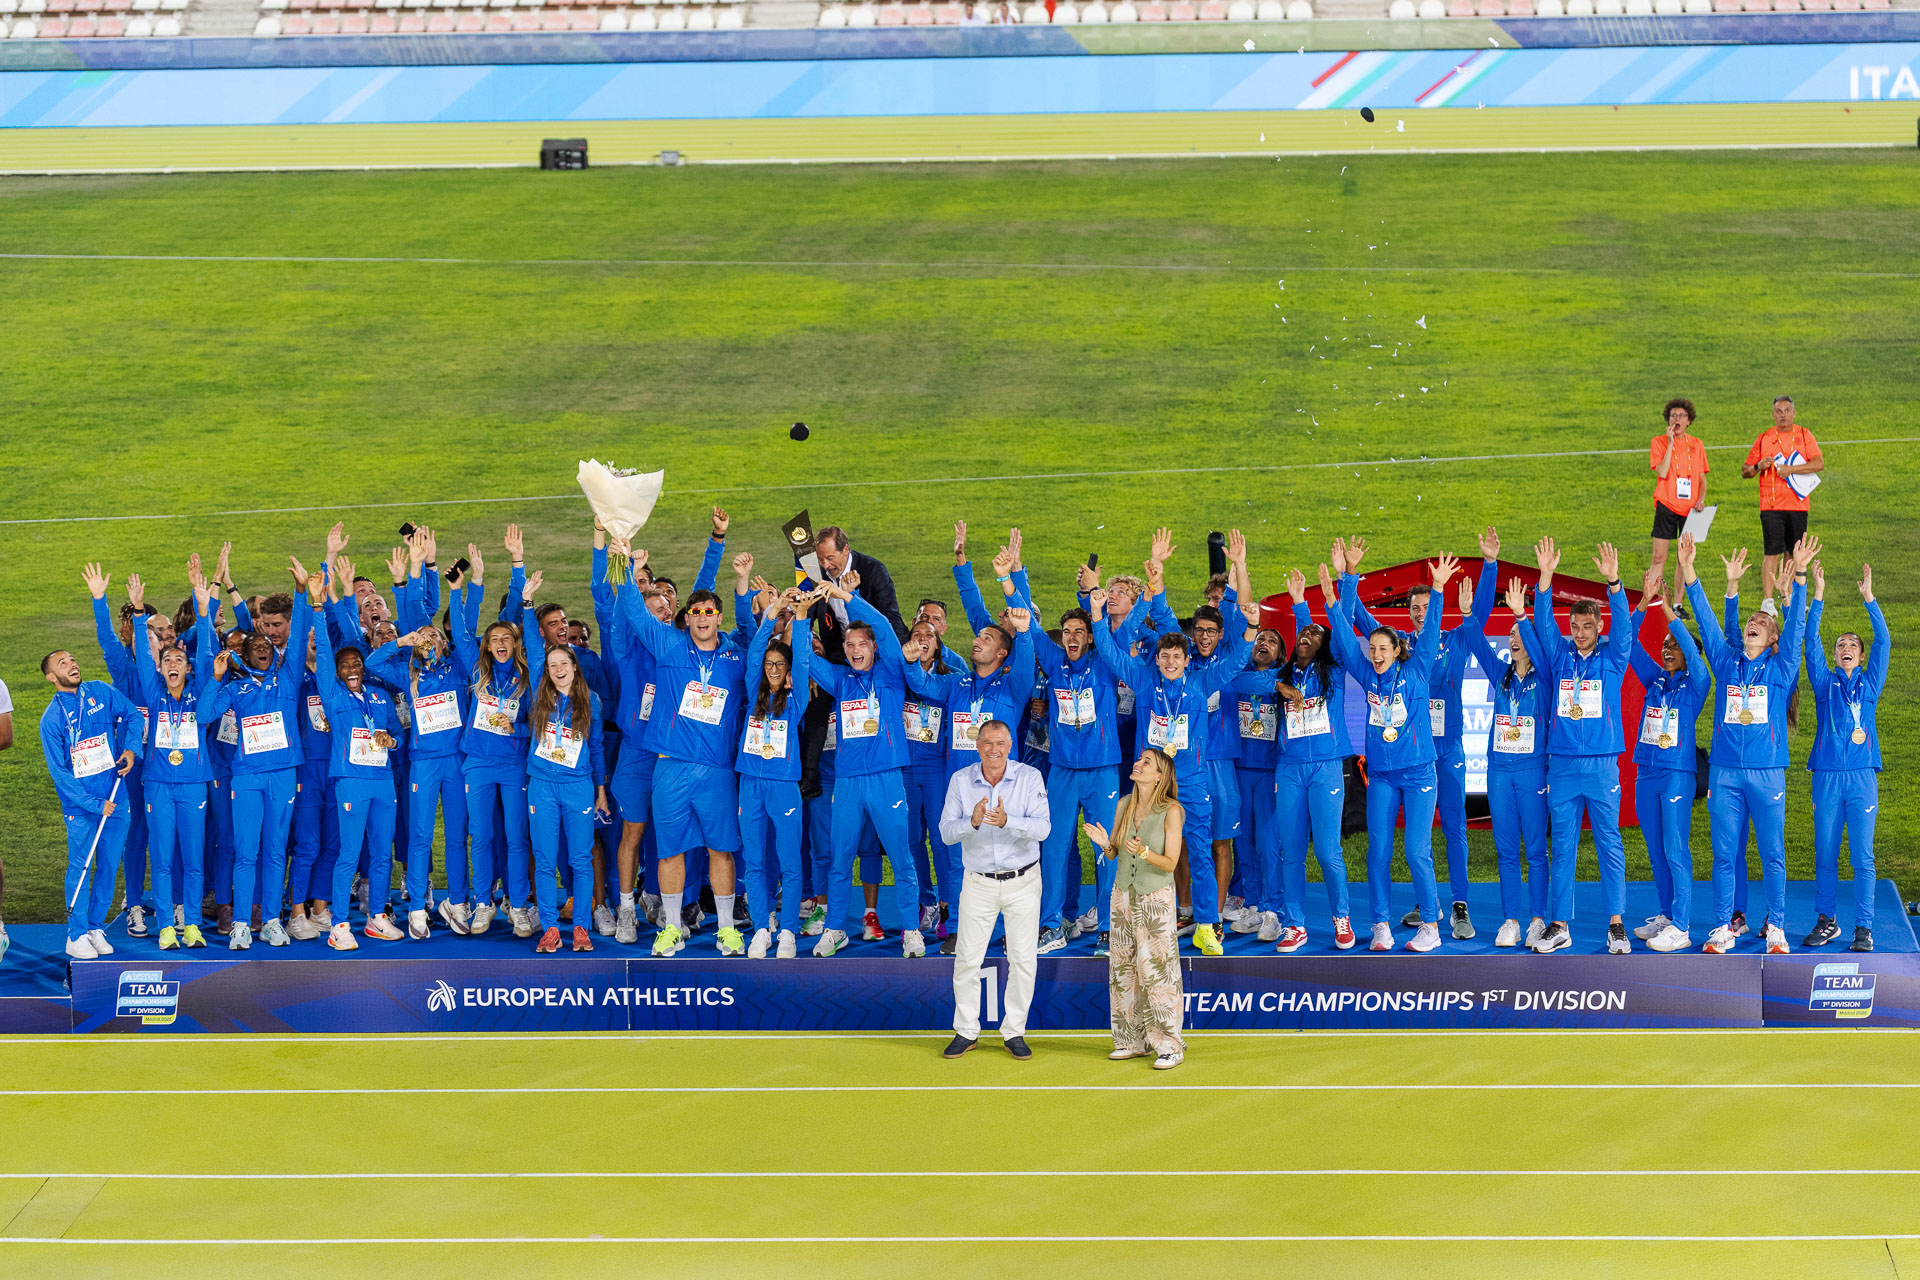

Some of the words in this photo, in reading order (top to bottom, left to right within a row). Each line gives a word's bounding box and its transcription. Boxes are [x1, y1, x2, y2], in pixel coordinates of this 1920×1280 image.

[688, 682, 718, 697] SPR
[1561, 681, 1590, 690] SPR
[1056, 691, 1073, 700] SPA
[1728, 687, 1755, 697] SPR
[416, 696, 446, 708] SPAR
[1288, 700, 1314, 711] SAR
[87, 703, 104, 716] ITALIA
[1239, 703, 1266, 713] SPR
[682, 710, 705, 720] MADRID
[955, 714, 981, 723] SPA
[1462, 708, 1494, 731] AM
[243, 716, 272, 727] SPAR
[1496, 717, 1523, 727] SPR
[422, 723, 445, 732] MADRID
[846, 730, 865, 738] MADRID
[248, 744, 270, 752] MADRID
[1823, 977, 1865, 988] TEAM
[129, 984, 168, 995] TEAM
[980, 966, 998, 1022] 1
[463, 987, 594, 1006] EUROPEAN
[601, 987, 735, 1006] ATHLETICS
[1181, 992, 1251, 1012] TEAM
[1258, 990, 1473, 1011] CHAMPIONSHIPS
[1479, 988, 1507, 1011] 1ST
[1512, 990, 1625, 1010] DIVISION
